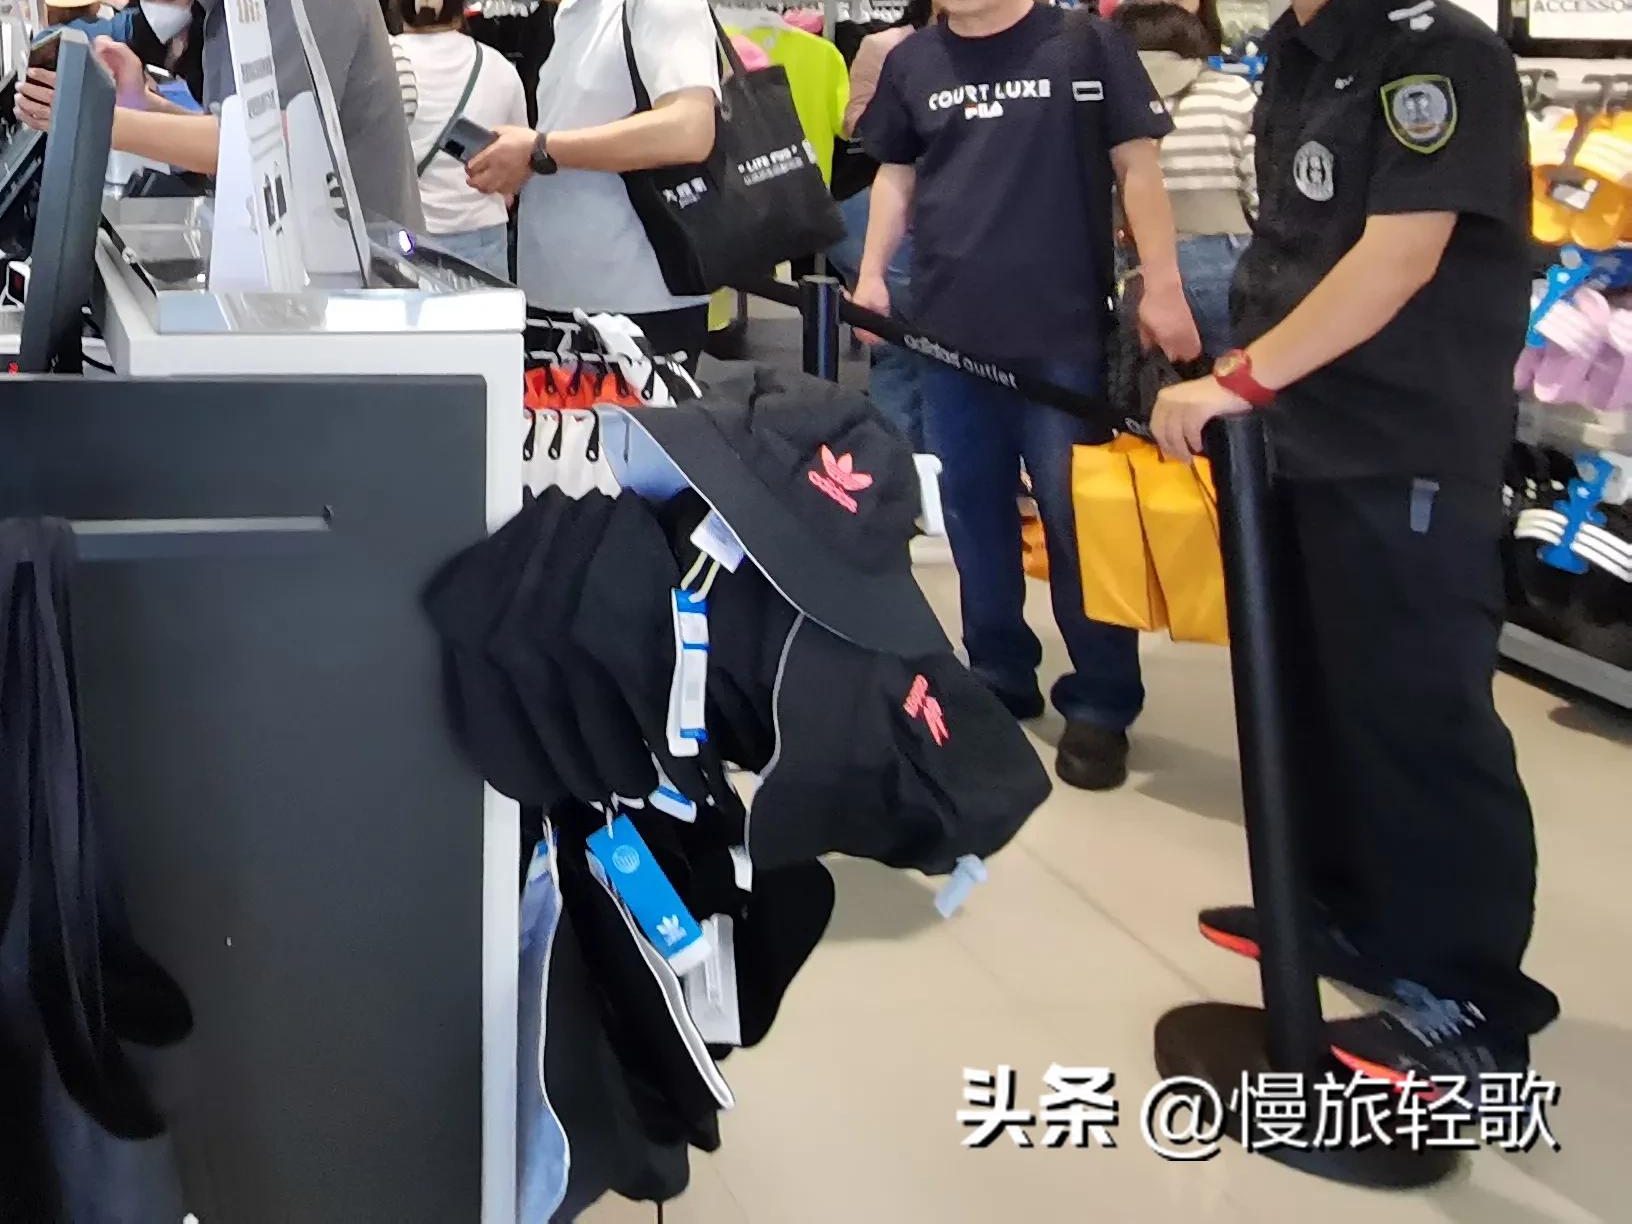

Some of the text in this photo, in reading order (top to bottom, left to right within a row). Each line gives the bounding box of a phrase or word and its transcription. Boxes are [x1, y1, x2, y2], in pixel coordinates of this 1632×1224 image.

[928, 78, 1051, 111] COURT LUXE
[965, 100, 1004, 120] FILA
[962, 356, 1019, 390] outlet
